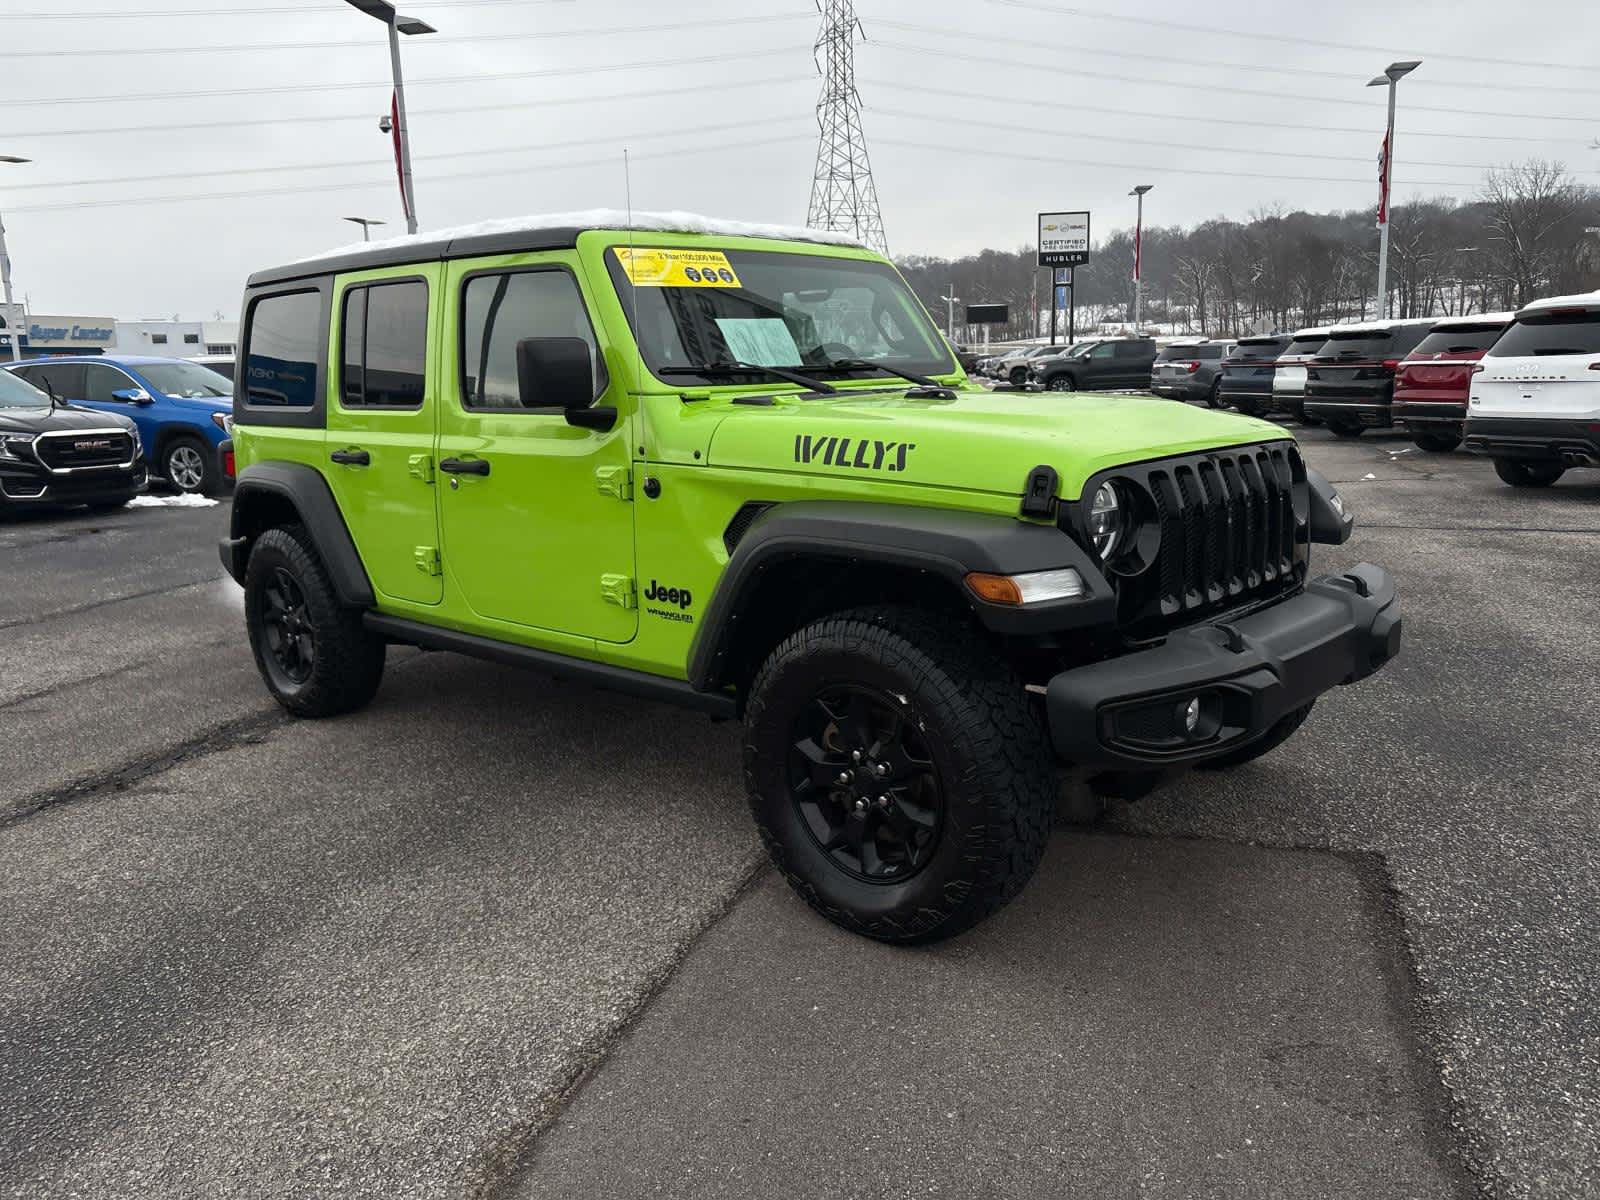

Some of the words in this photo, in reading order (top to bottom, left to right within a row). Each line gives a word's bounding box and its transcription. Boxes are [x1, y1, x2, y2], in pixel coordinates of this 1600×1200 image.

[29, 324, 68, 343] Super
[70, 325, 113, 341] Center
[795, 435, 916, 472] WILLYS
[644, 579, 692, 610] Jeep
